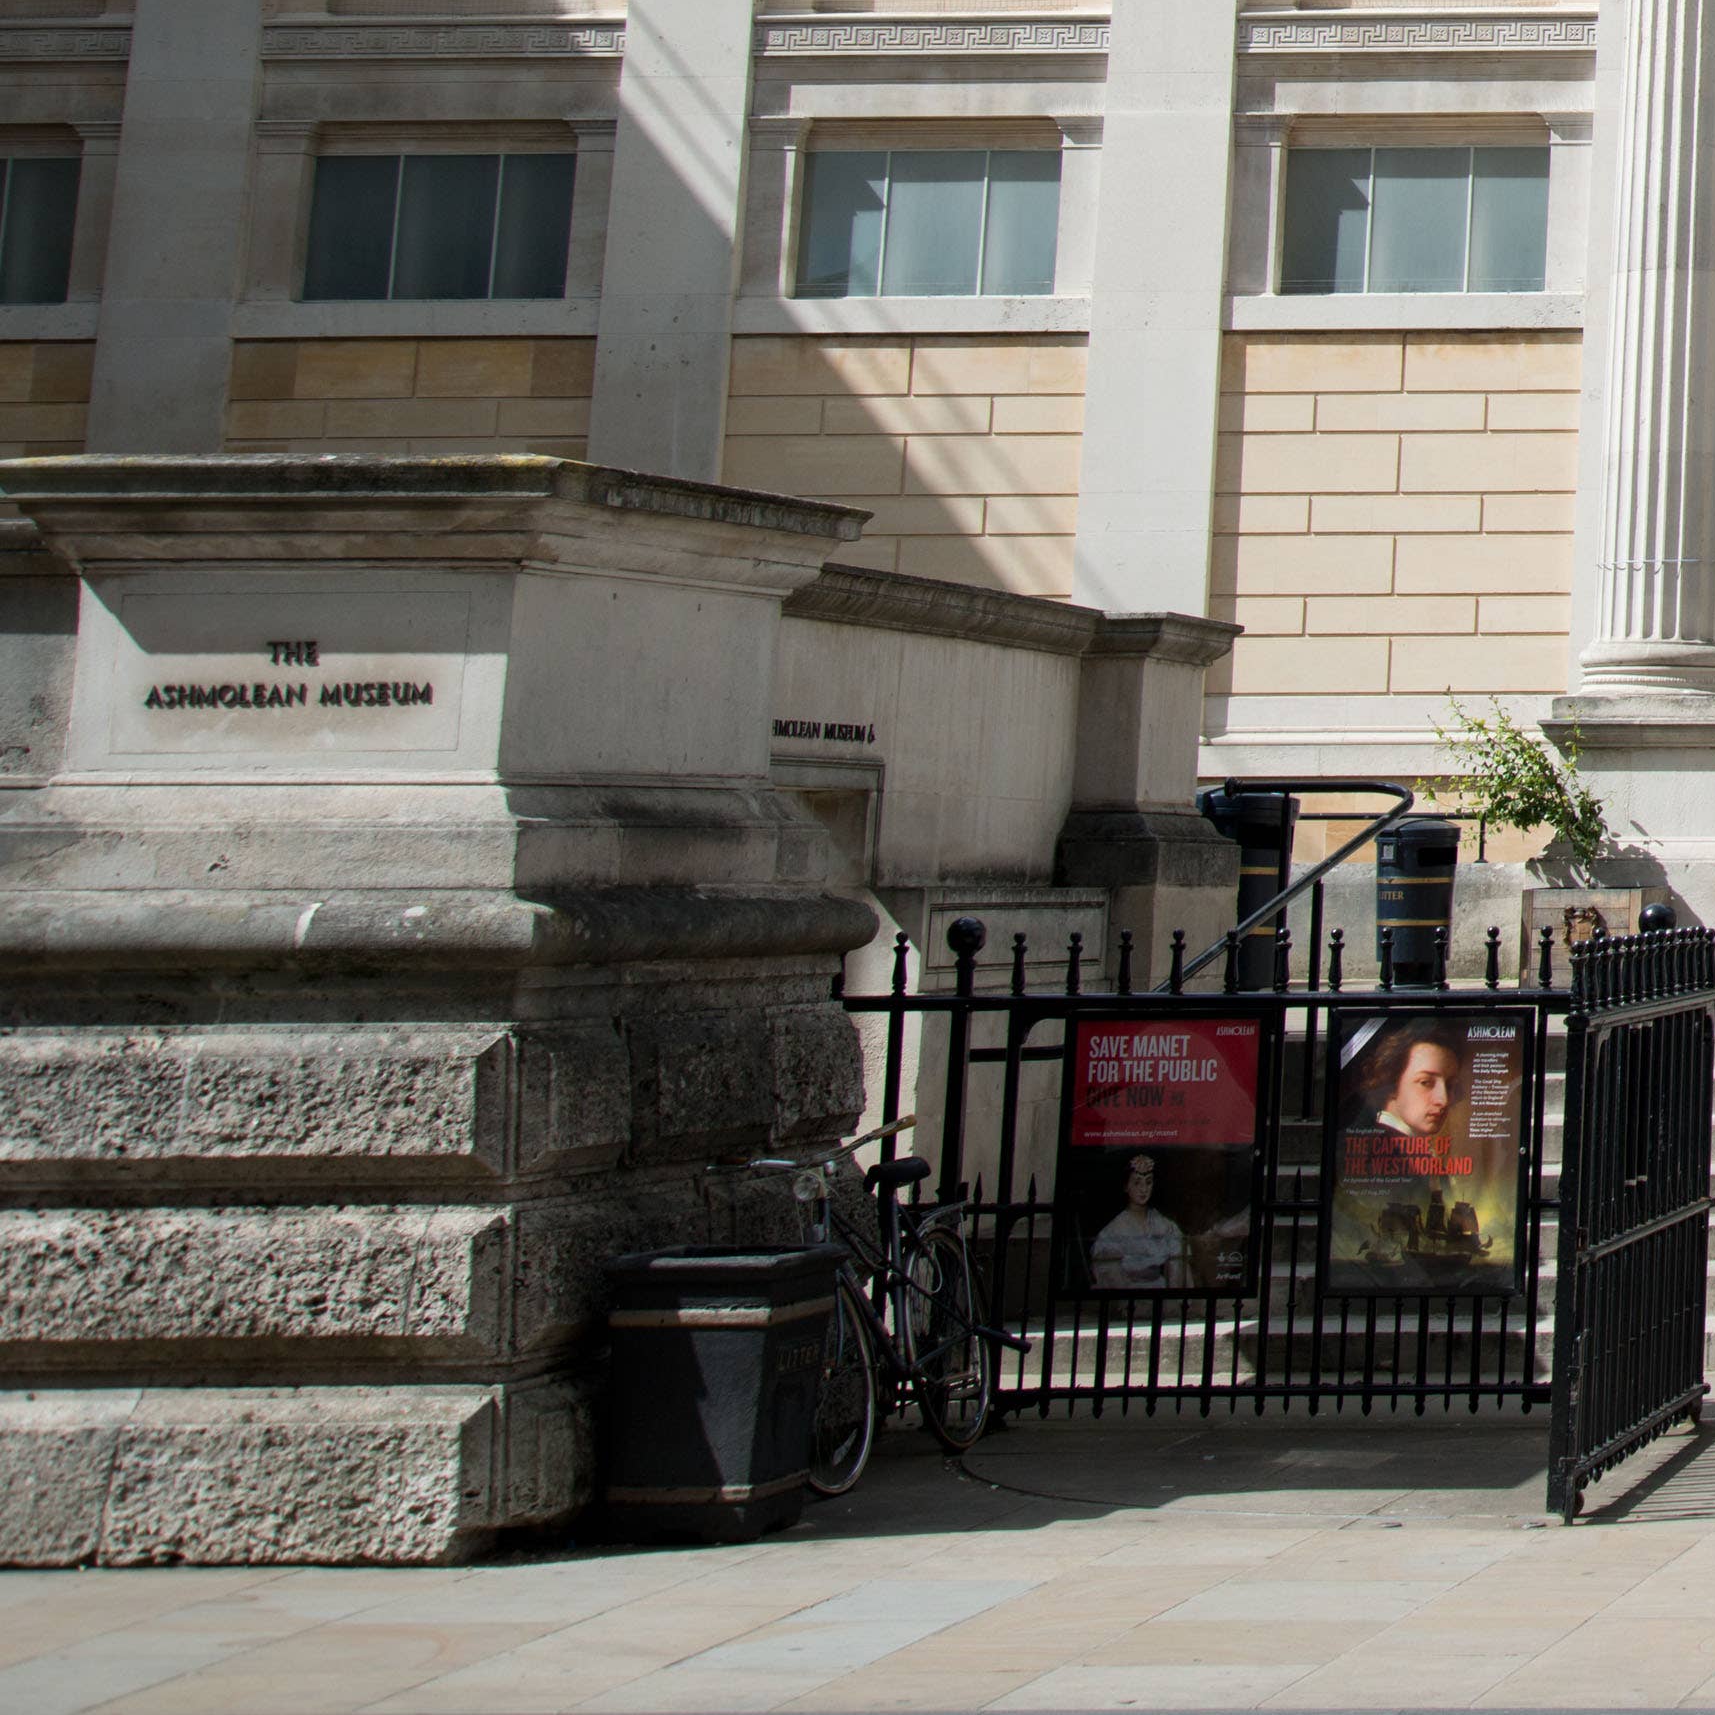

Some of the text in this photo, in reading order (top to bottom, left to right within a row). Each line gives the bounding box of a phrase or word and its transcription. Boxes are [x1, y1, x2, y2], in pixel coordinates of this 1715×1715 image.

[267, 641, 320, 667] THE
[144, 683, 434, 709] ASHMOLEAN MUSEUM
[824, 722, 866, 742] MUSEUM
[1216, 1026, 1255, 1036] ASHMOLEAN
[1467, 1027, 1516, 1038] ASHMOLEAN
[1089, 1035, 1190, 1058] SAVE MANET
[1088, 1059, 1217, 1083] FOR THE PUBLIC
[1087, 1086, 1120, 1108] GIVE
[1126, 1086, 1165, 1107] NOW
[1345, 1136, 1452, 1154] THE CAPTURE OF
[1344, 1156, 1473, 1175] THE WESTMORLAND
